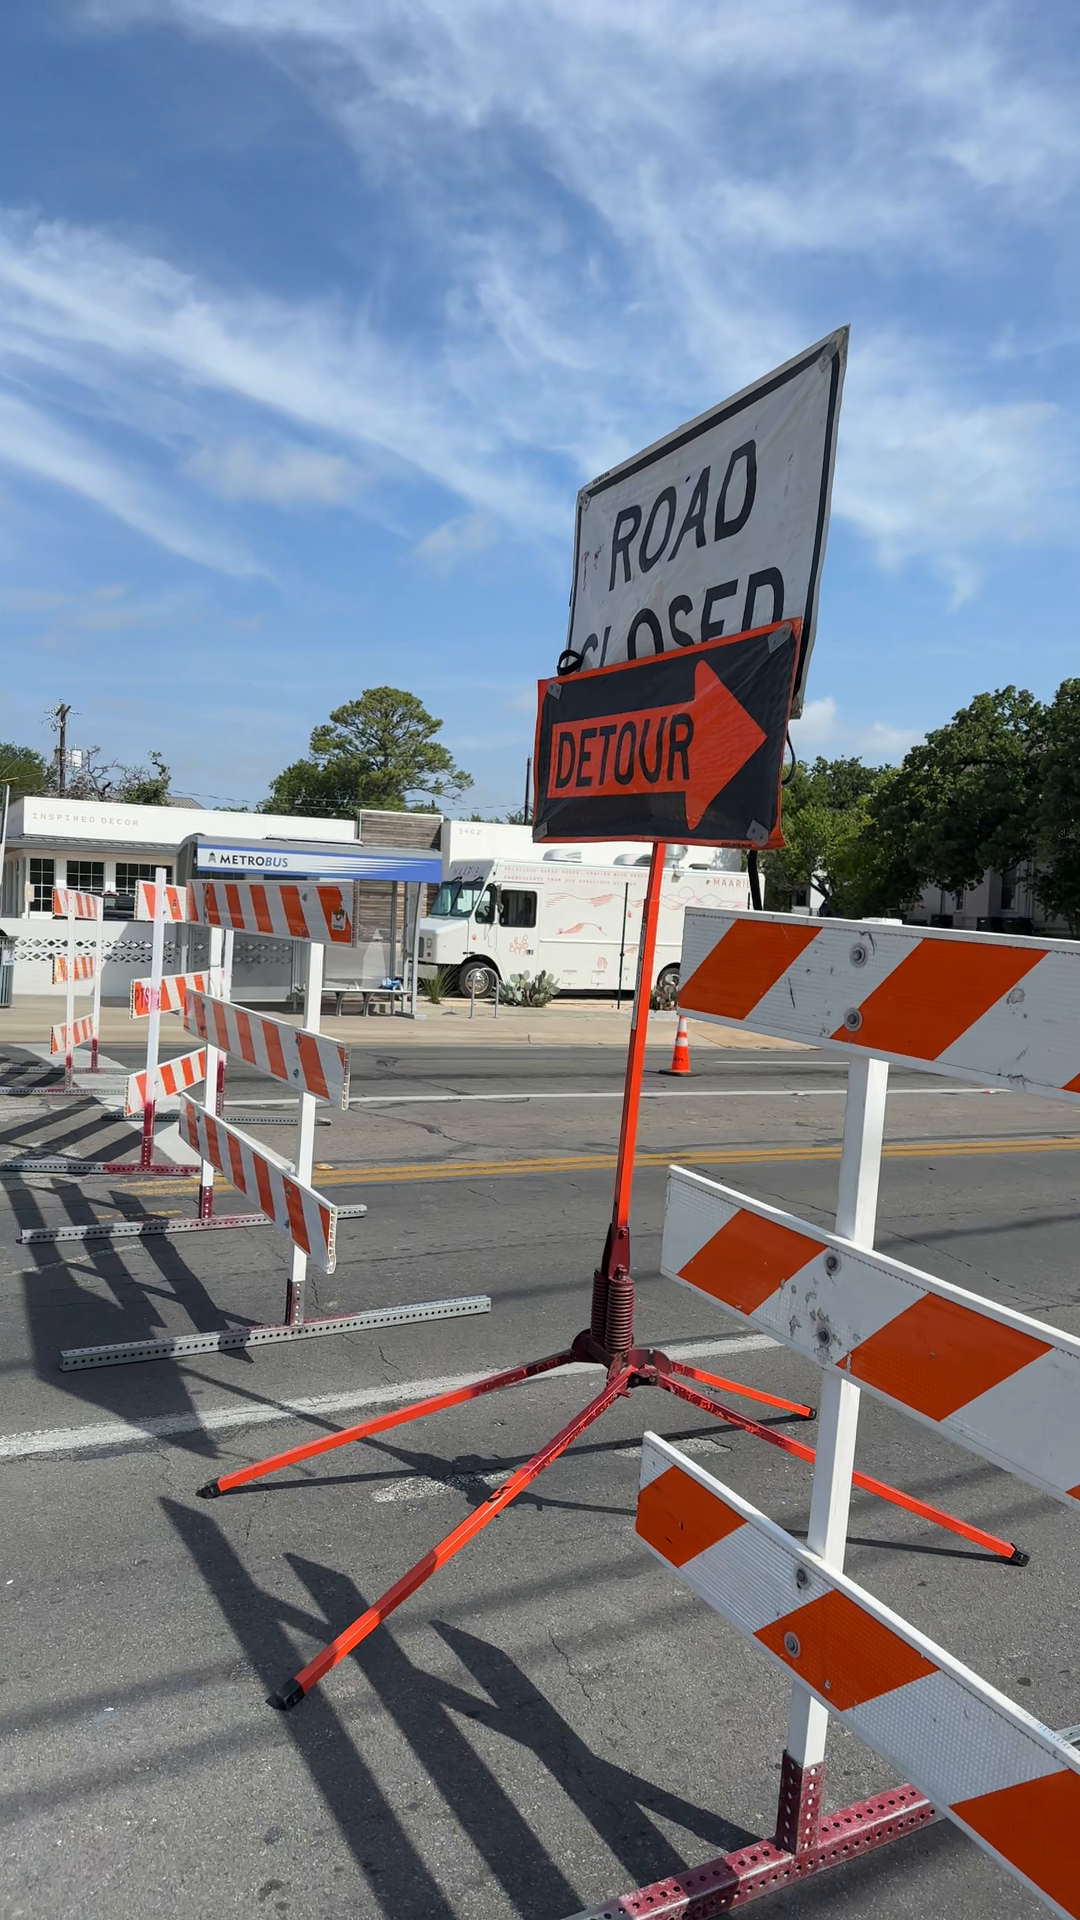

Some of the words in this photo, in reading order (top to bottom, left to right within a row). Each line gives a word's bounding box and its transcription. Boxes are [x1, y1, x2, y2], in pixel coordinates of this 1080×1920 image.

[608, 439, 757, 592] ROAD
[555, 712, 694, 789] DETOUR
[32, 812, 96, 823] INSPIRED
[101, 817, 139, 826] DECOR
[458, 828, 482, 836] 3402
[220, 854, 288, 867] METROBUS
